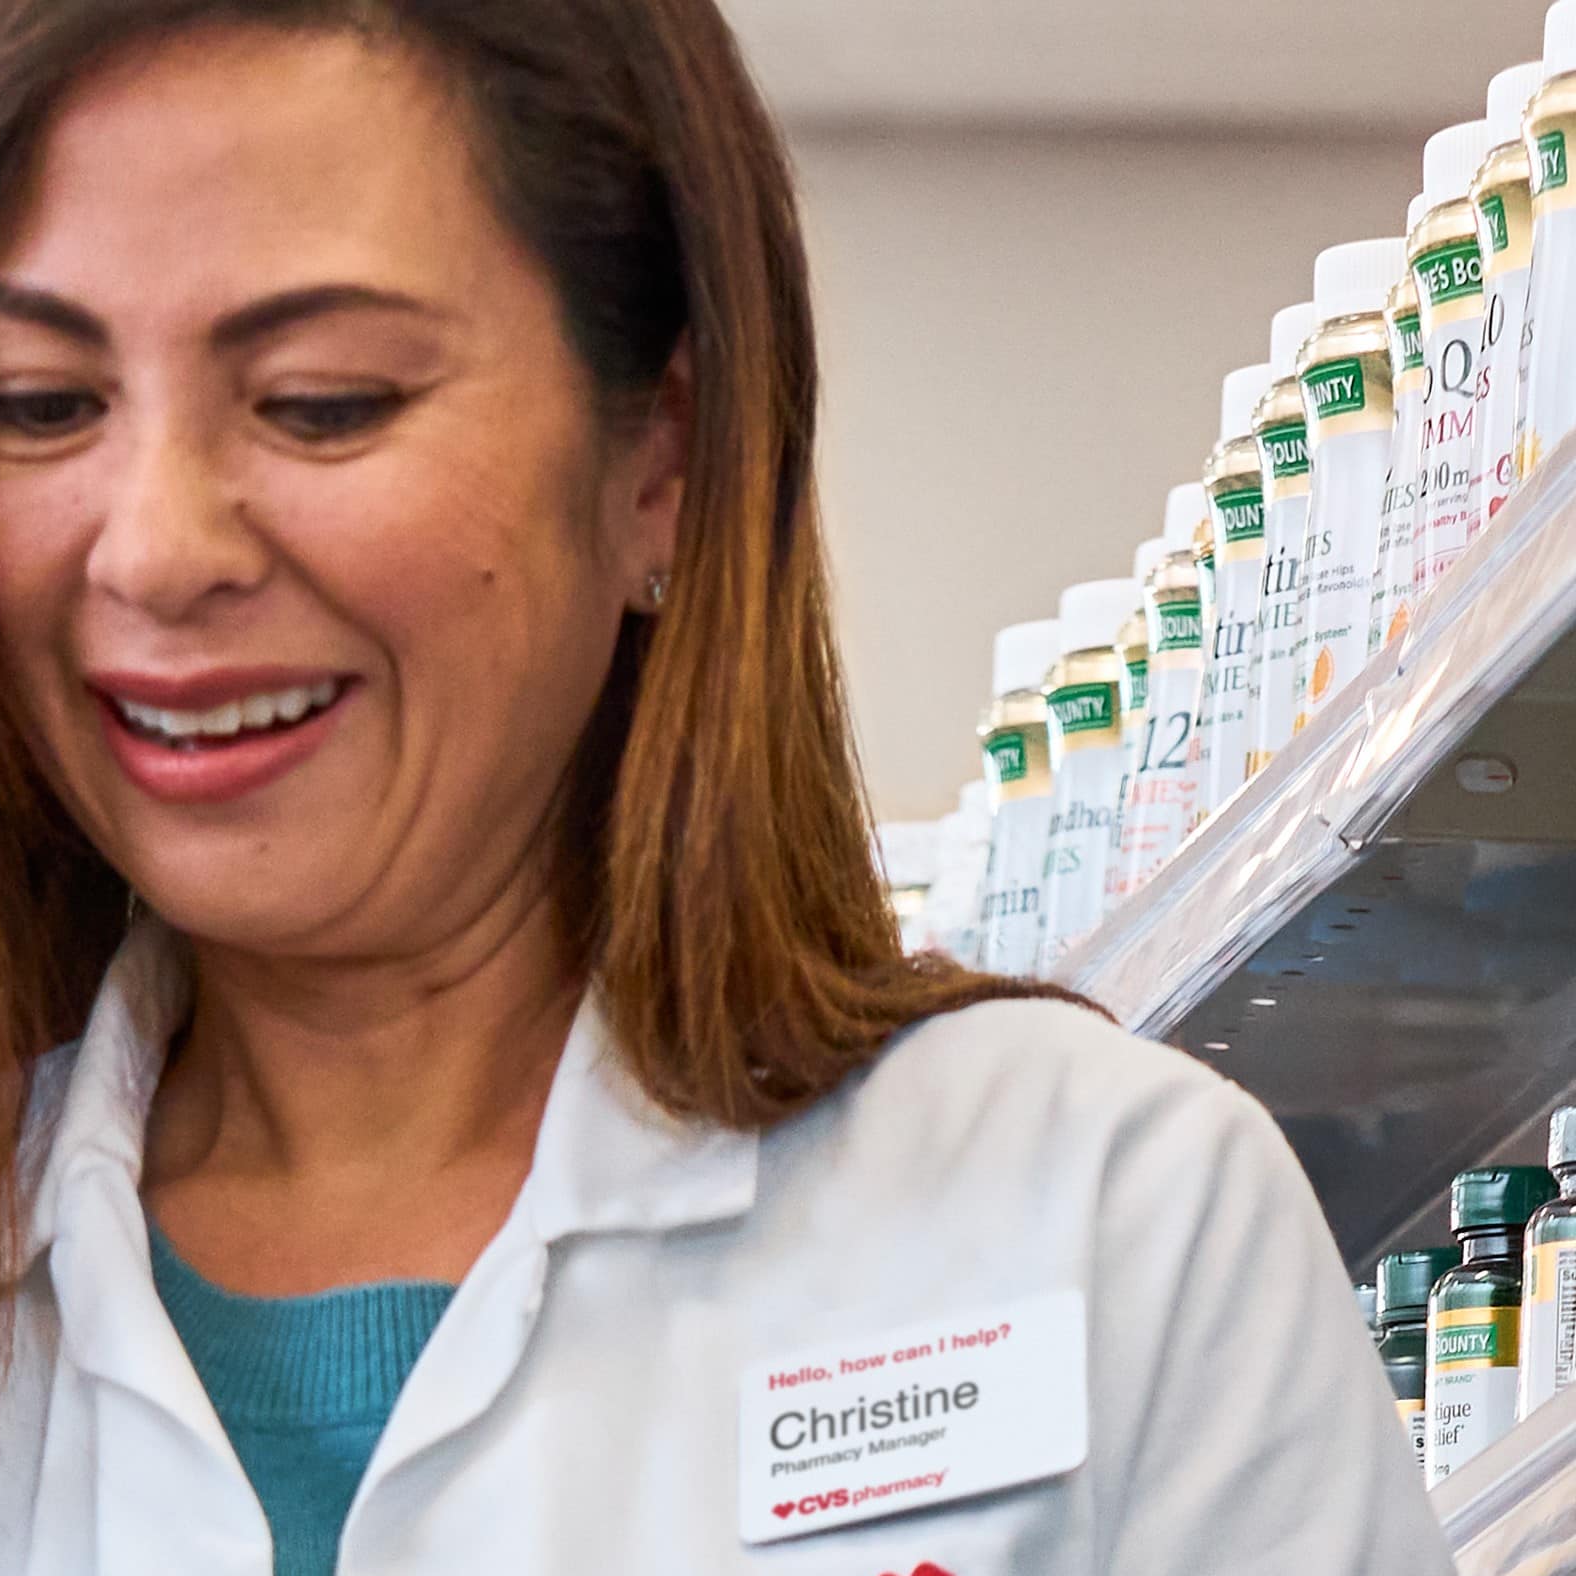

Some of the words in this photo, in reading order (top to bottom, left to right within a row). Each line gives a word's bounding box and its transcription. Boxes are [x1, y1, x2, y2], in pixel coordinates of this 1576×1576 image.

[768, 1366, 833, 1391] Hello,
[839, 1354, 886, 1375] how
[892, 1342, 932, 1363] can
[938, 1338, 945, 1352] I
[951, 1323, 1012, 1350] help?
[769, 1379, 980, 1451] Christine
[770, 1447, 863, 1478] Pharmacy
[868, 1427, 947, 1456] Manager
[798, 1488, 849, 1516] CVS
[852, 1469, 948, 1508] pharmacy
